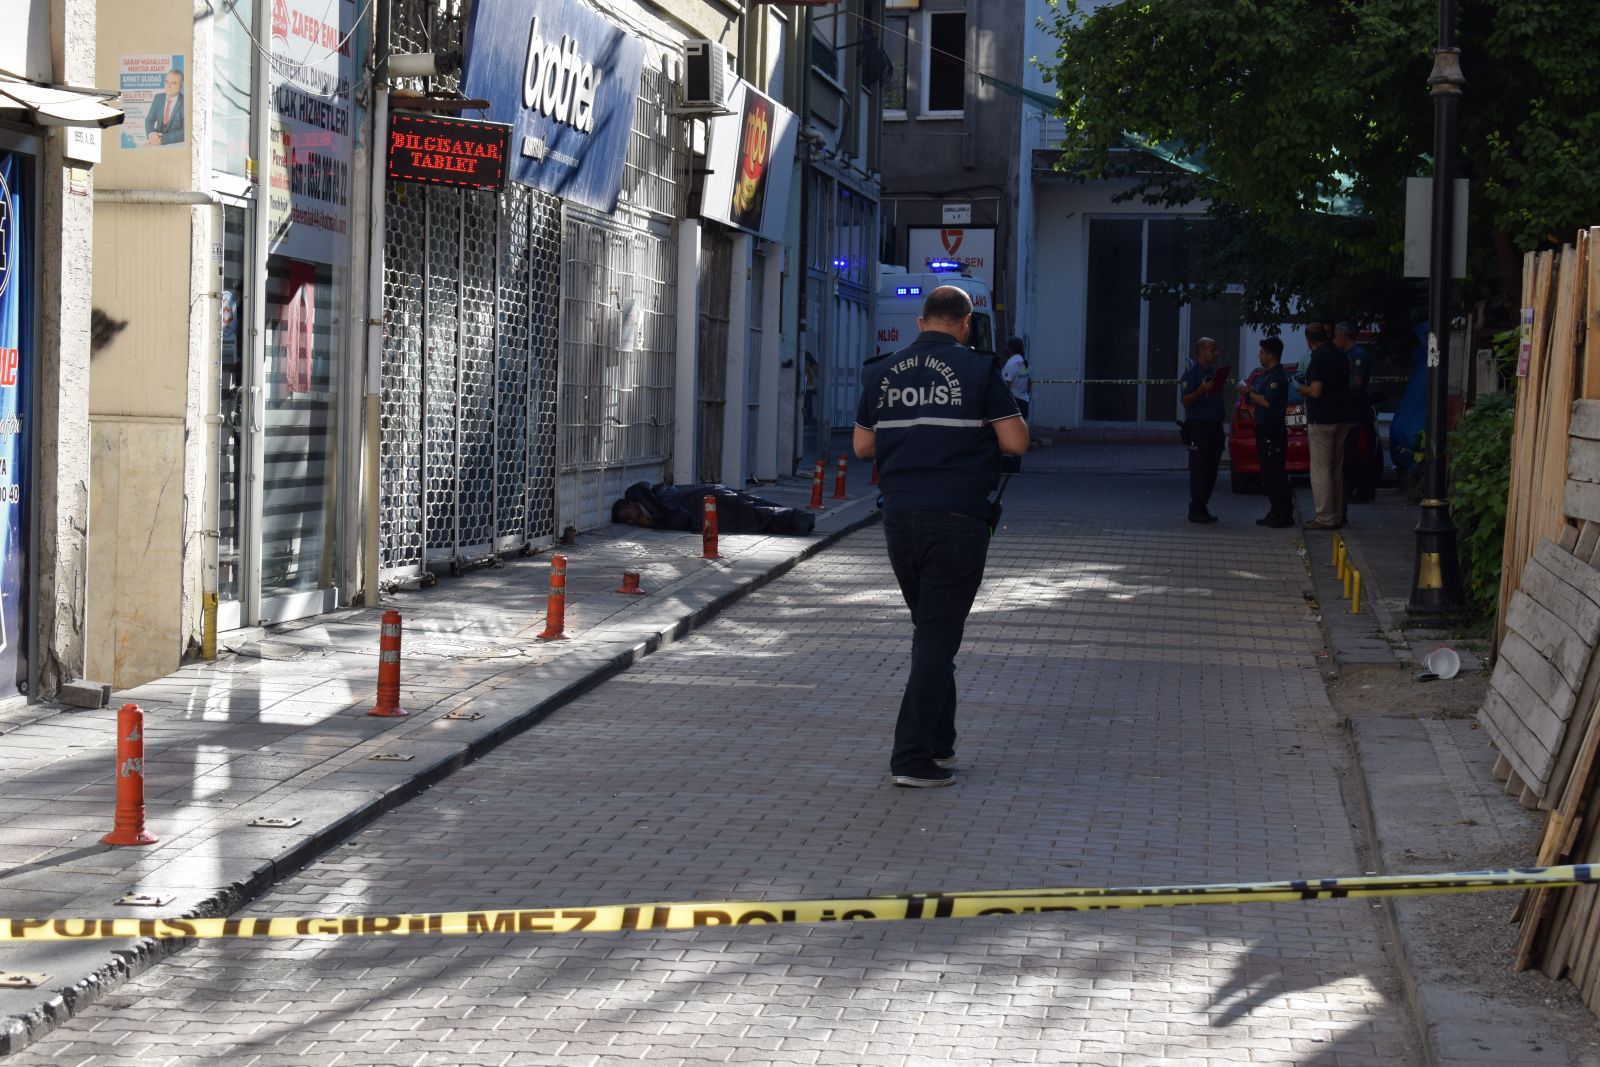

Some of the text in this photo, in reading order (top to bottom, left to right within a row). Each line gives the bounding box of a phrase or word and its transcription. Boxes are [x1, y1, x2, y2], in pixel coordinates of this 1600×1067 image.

[292, 9, 351, 58] ZAFER EMLAK
[122, 75, 140, 83] AHMET
[524, 16, 603, 134] brother
[299, 92, 349, 136] HİZMETLERİ
[392, 130, 499, 159] BİLGİSAYAR
[411, 151, 478, 173] TABLET
[965, 256, 984, 267] SEN
[890, 353, 919, 375] YERİ
[924, 354, 962, 406] İNCELEME
[888, 380, 949, 408] POLİS
[9, 484, 20, 504] 40
